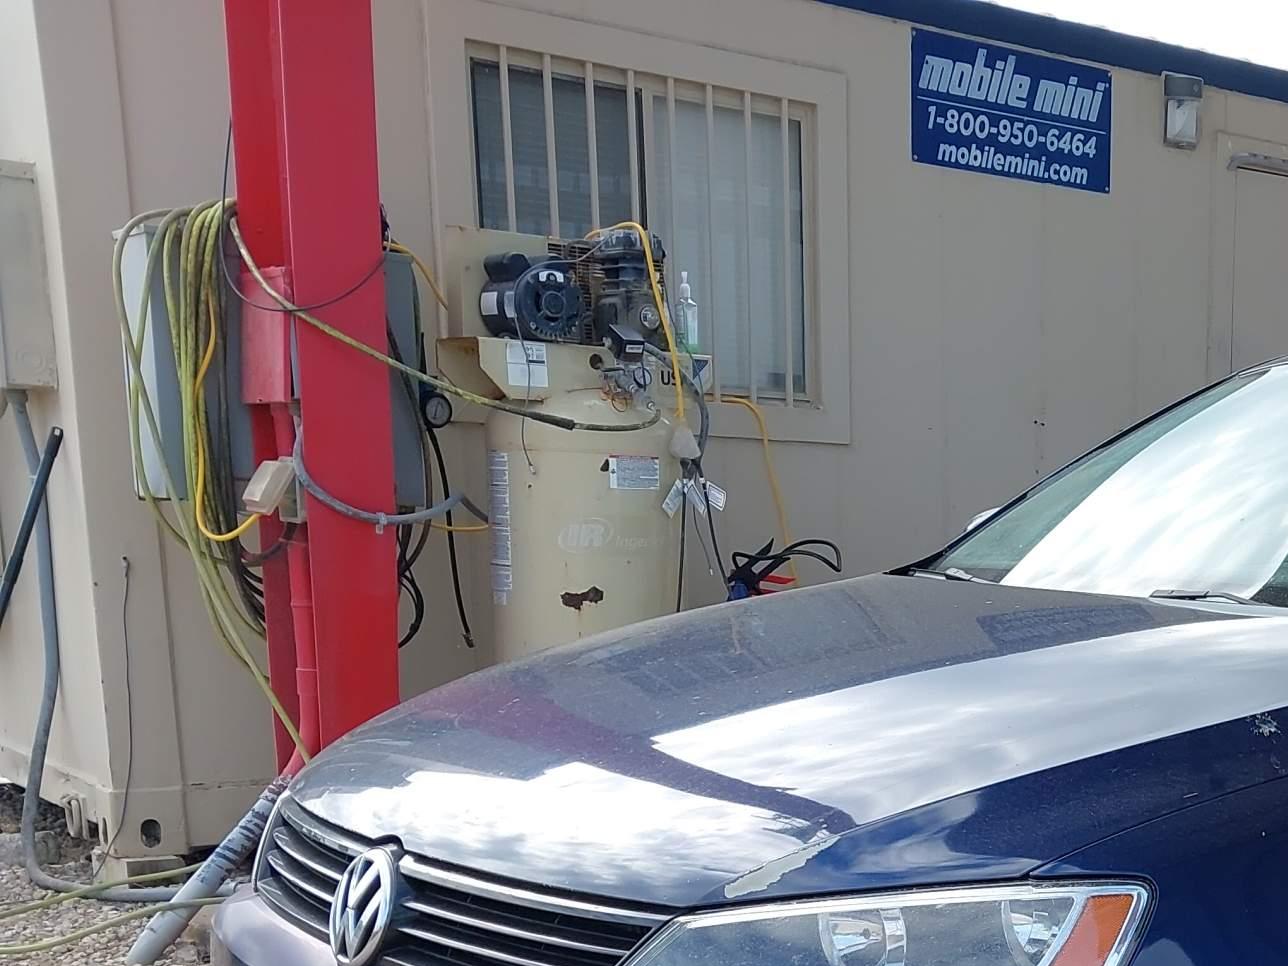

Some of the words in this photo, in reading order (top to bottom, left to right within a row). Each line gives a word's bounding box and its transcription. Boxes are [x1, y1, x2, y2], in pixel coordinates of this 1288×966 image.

[918, 47, 1031, 109] mobile
[1033, 75, 1105, 123] mini
[926, 104, 1097, 159] 1-800-950-6464
[937, 142, 1088, 185] mobilemini.com
